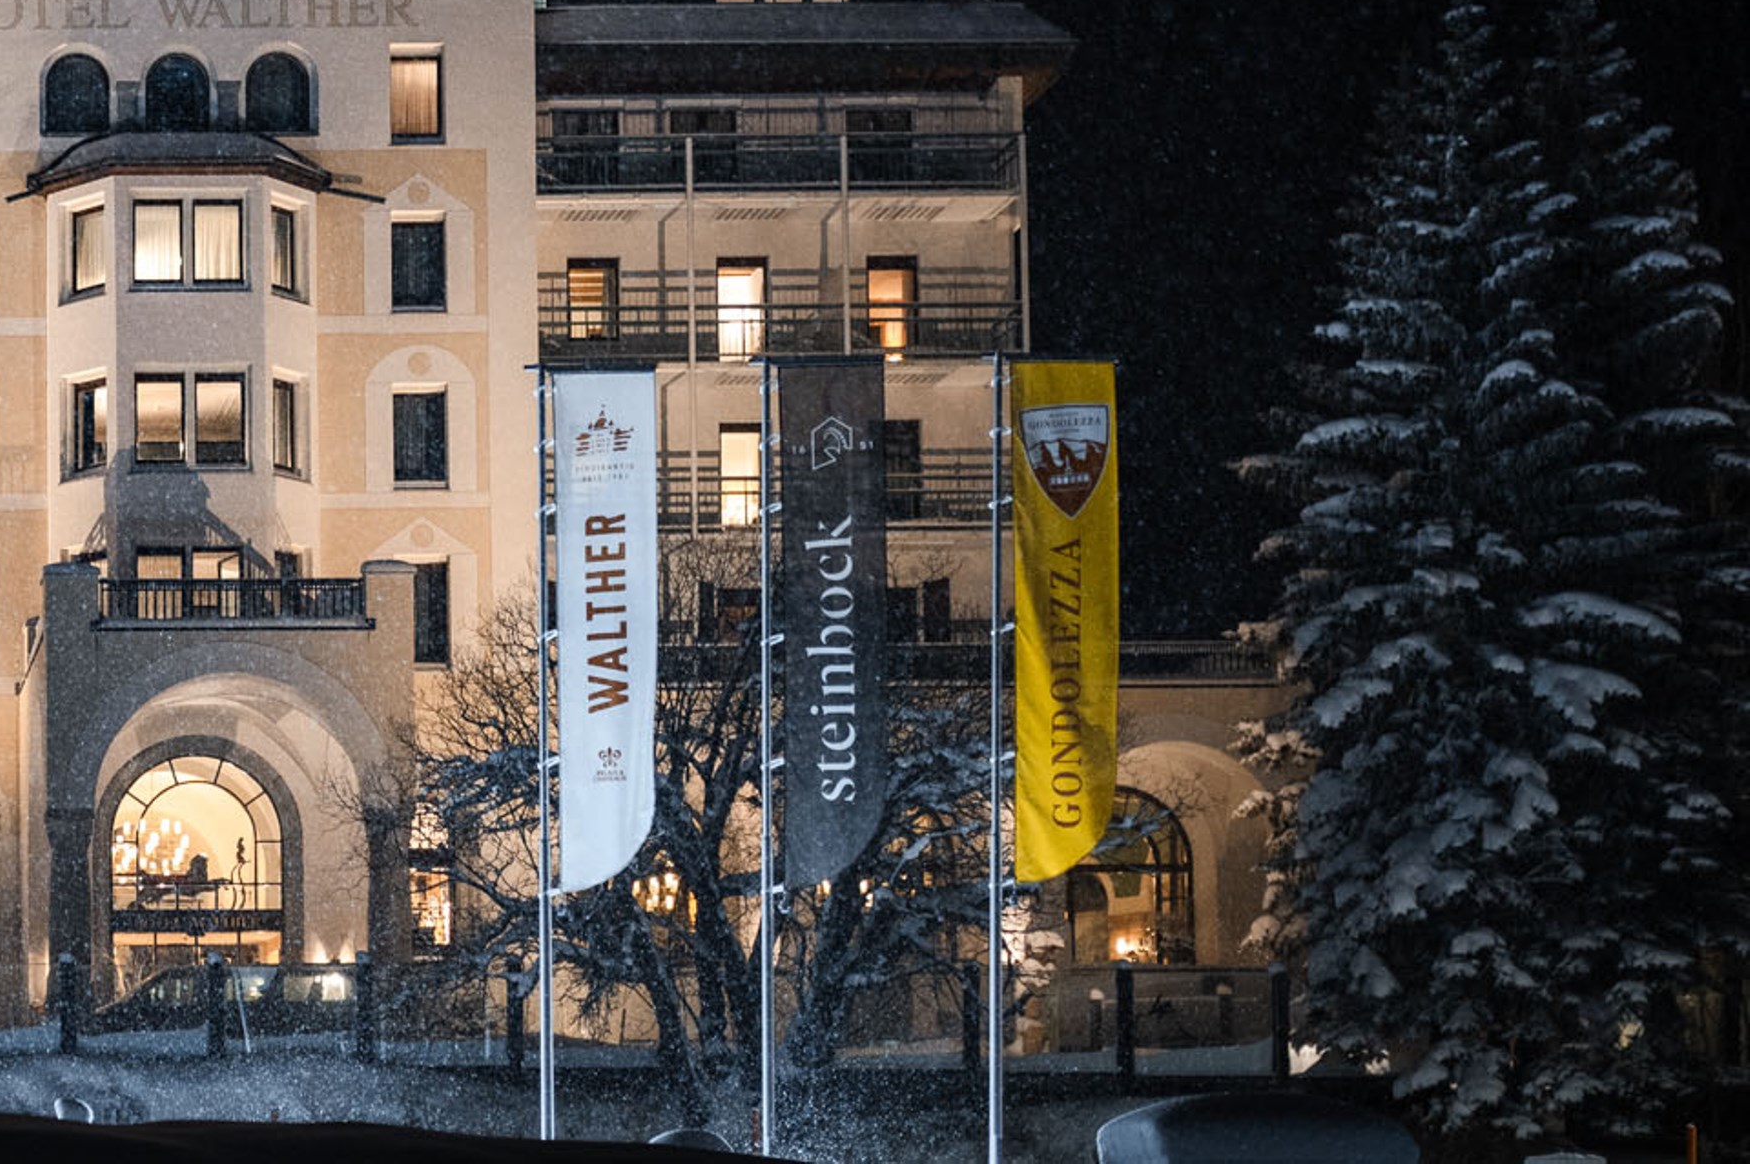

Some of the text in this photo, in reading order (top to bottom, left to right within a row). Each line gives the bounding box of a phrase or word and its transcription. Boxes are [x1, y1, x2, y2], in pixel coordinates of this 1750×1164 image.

[584, 513, 629, 714] WALTHER
[804, 515, 856, 804] steinbock
[1049, 536, 1083, 829] GONDOLEZZA
